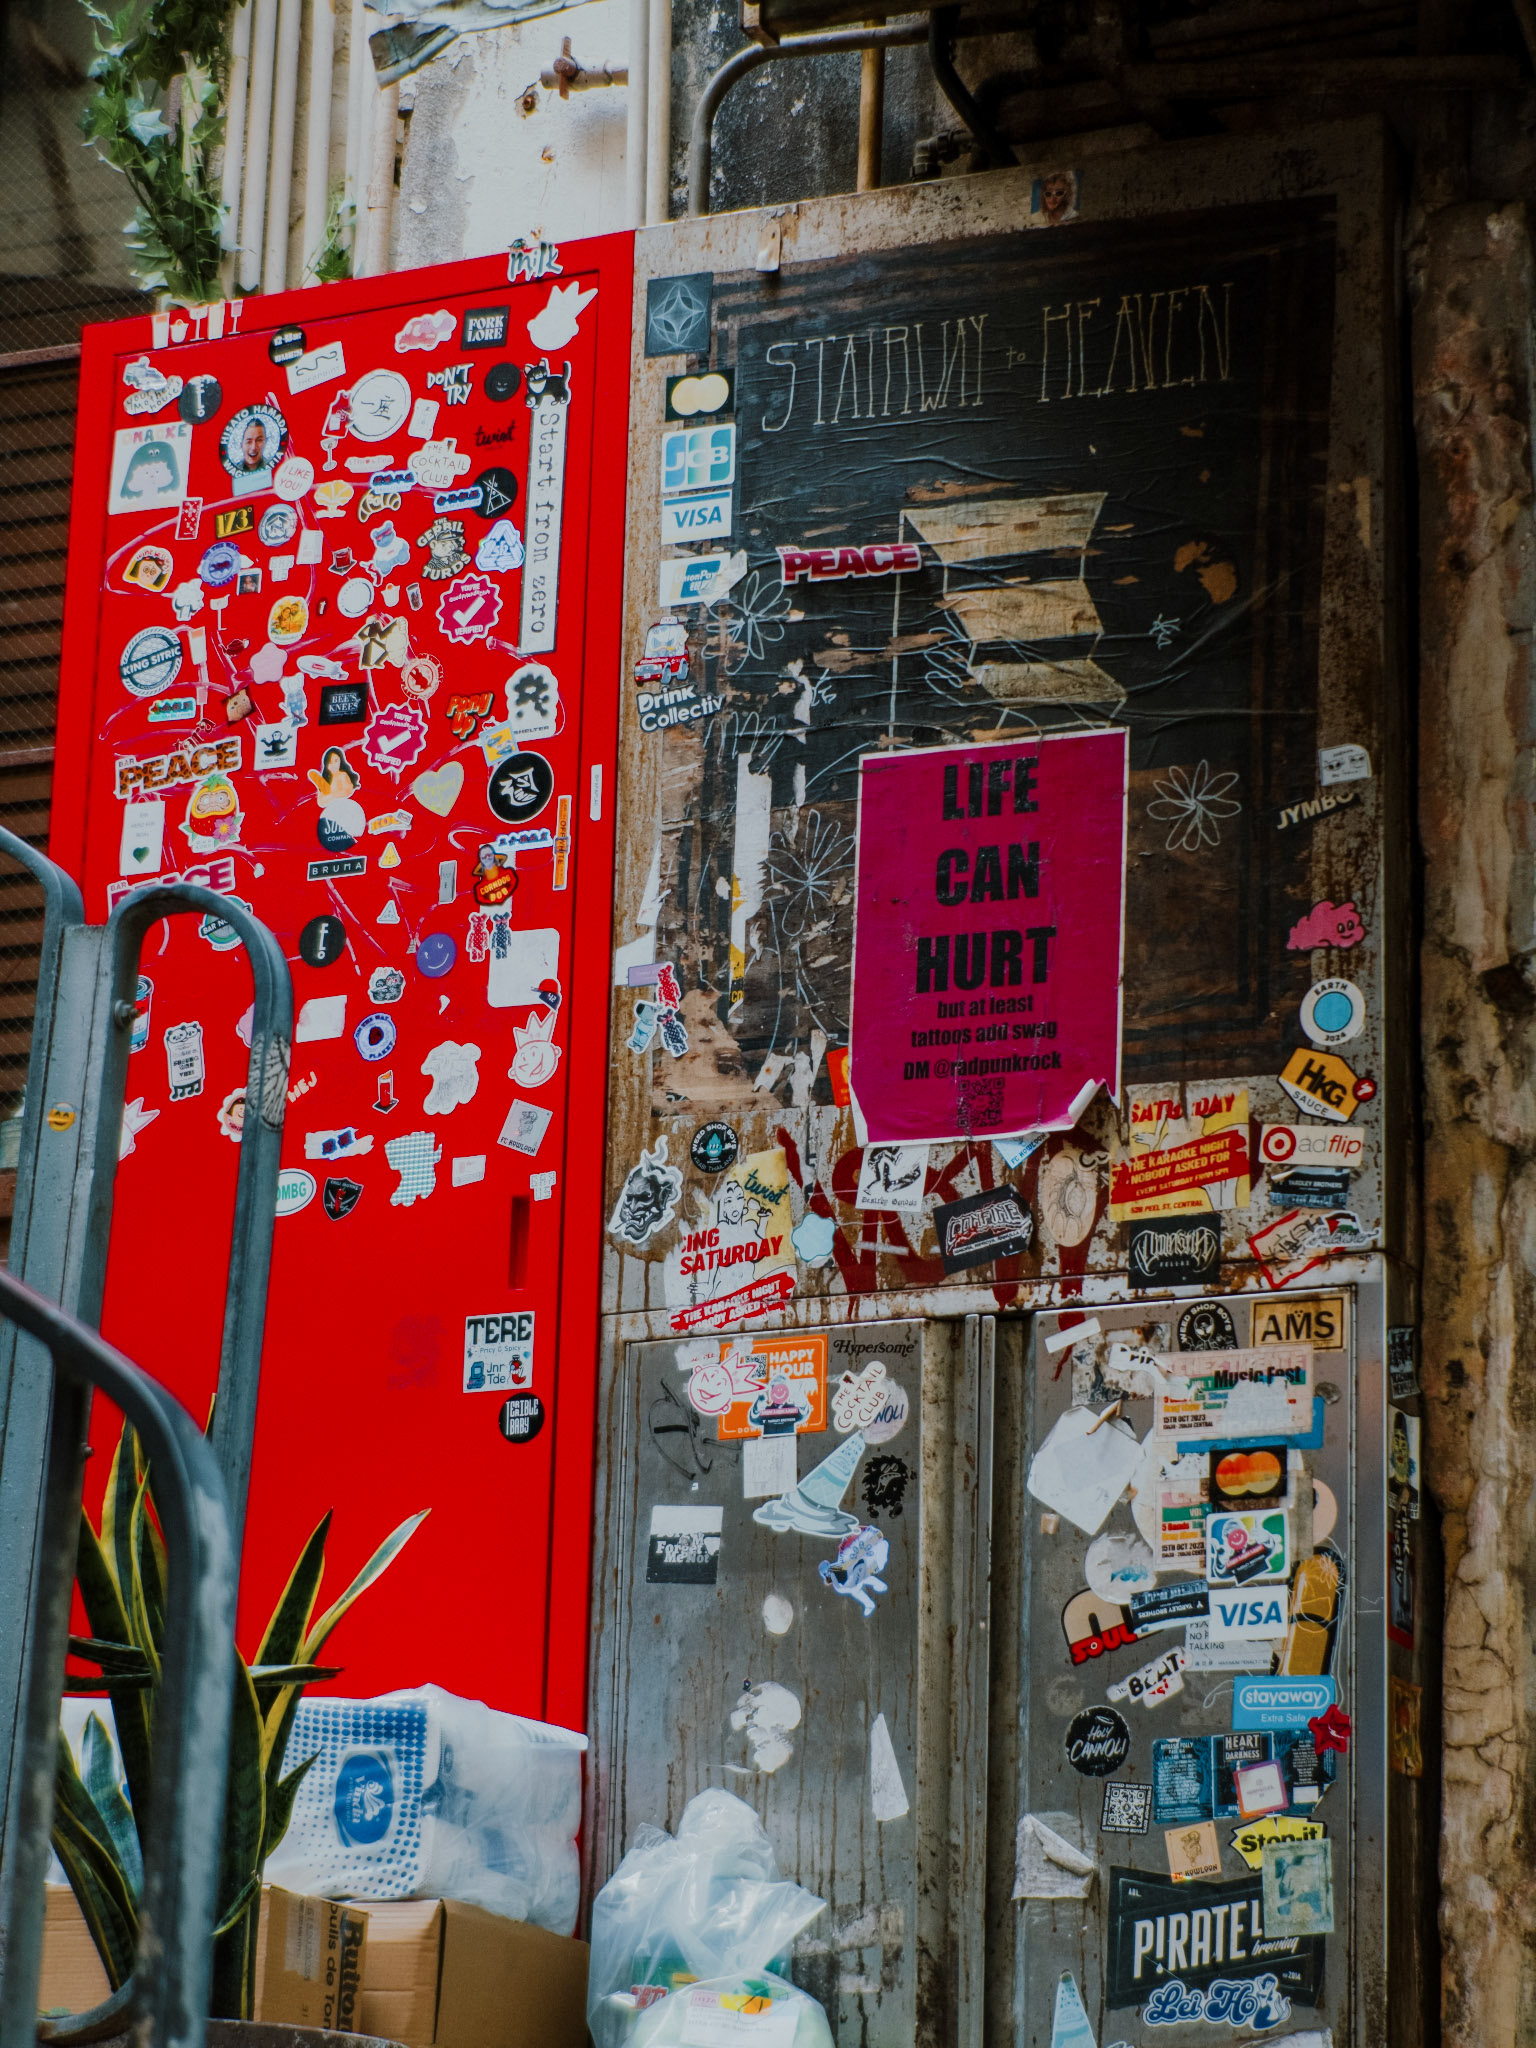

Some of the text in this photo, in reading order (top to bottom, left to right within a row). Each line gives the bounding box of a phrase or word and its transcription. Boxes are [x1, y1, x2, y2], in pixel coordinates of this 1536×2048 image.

[467, 328, 503, 342] LORE
[468, 315, 504, 331] FORK
[762, 283, 1234, 431] STAIRWAY to HEAVEN
[427, 363, 474, 388] DON'T
[446, 383, 473, 405] TRY
[221, 408, 249, 445] HISATO
[254, 405, 287, 435] HAMADA
[412, 455, 466, 470] COCKTAIL
[540, 413, 559, 491] Start
[665, 446, 729, 471] JCB
[421, 470, 449, 484] CLUB
[674, 506, 722, 528] VISA
[422, 553, 471, 580] TURDS
[783, 545, 920, 581] PEACE
[531, 576, 546, 633] zero
[454, 625, 483, 635] VERIFIED
[122, 646, 181, 676] KING SITRIC
[328, 701, 359, 712] KNEES
[332, 693, 359, 704] BEE'S
[446, 692, 493, 717] Pony
[637, 685, 696, 714] Drink
[640, 696, 723, 733] Collectiv
[513, 725, 549, 735] SHELTER
[119, 740, 239, 795] PEACE
[942, 756, 1040, 821] LIFE
[312, 862, 362, 875] BRUMA
[936, 841, 1040, 907] CAN
[915, 925, 1057, 993] HURT
[1313, 981, 1348, 997] EARTH
[938, 995, 1034, 1019] but at least
[911, 1021, 1058, 1047] tattoos add swag
[904, 1050, 1061, 1080] DM @radpunkrock
[1296, 1058, 1347, 1109] HKG
[1292, 1090, 1329, 1117] SAUCE
[692, 1130, 705, 1152] WEED
[1148, 1146, 1197, 1171] KARAOKE
[1200, 1138, 1231, 1156] NIGHT
[1131, 1151, 1230, 1184] NOBODY ASKED FOR
[744, 1169, 790, 1206] twist
[1136, 1185, 1157, 1197] EVERY
[1159, 1176, 1193, 1191] SATURDAY
[680, 1235, 783, 1276] SATURDAY
[683, 1280, 780, 1323] THE KARAOKE NIGHT
[729, 1300, 760, 1320] ASKED
[467, 1314, 532, 1345] TERE
[1180, 1303, 1232, 1343] WEED SHOP BOYS
[1261, 1311, 1334, 1341] AMS
[769, 1349, 815, 1364] HAPPY
[833, 1340, 915, 1358] Hypersome
[769, 1362, 815, 1378] HOUR
[1214, 1368, 1264, 1388] Music
[835, 1388, 851, 1406] THE
[837, 1368, 883, 1429] COCKTAIL
[858, 1390, 885, 1422] CLUB
[510, 1417, 529, 1434] BABY
[1138, 1608, 1168, 1618] BROTHERS
[1214, 1601, 1282, 1627] VISA
[1070, 1623, 1138, 1667] SOUL
[1189, 1642, 1224, 1650] TALKING
[1245, 1687, 1323, 1708] stayaway
[1261, 1713, 1306, 1722] Extra Safe
[1070, 1738, 1127, 1761] CANNOLI
[1225, 1735, 1259, 1748] HEART
[1225, 1750, 1260, 1760] DARKNESS
[1185, 1864, 1218, 1877] KOWLOON
[1133, 1901, 1247, 1979] PIRATE
[1251, 1937, 1299, 1956] brewing
[326, 1957, 336, 1986] de
[1147, 1982, 1258, 2023] Lei Ho
